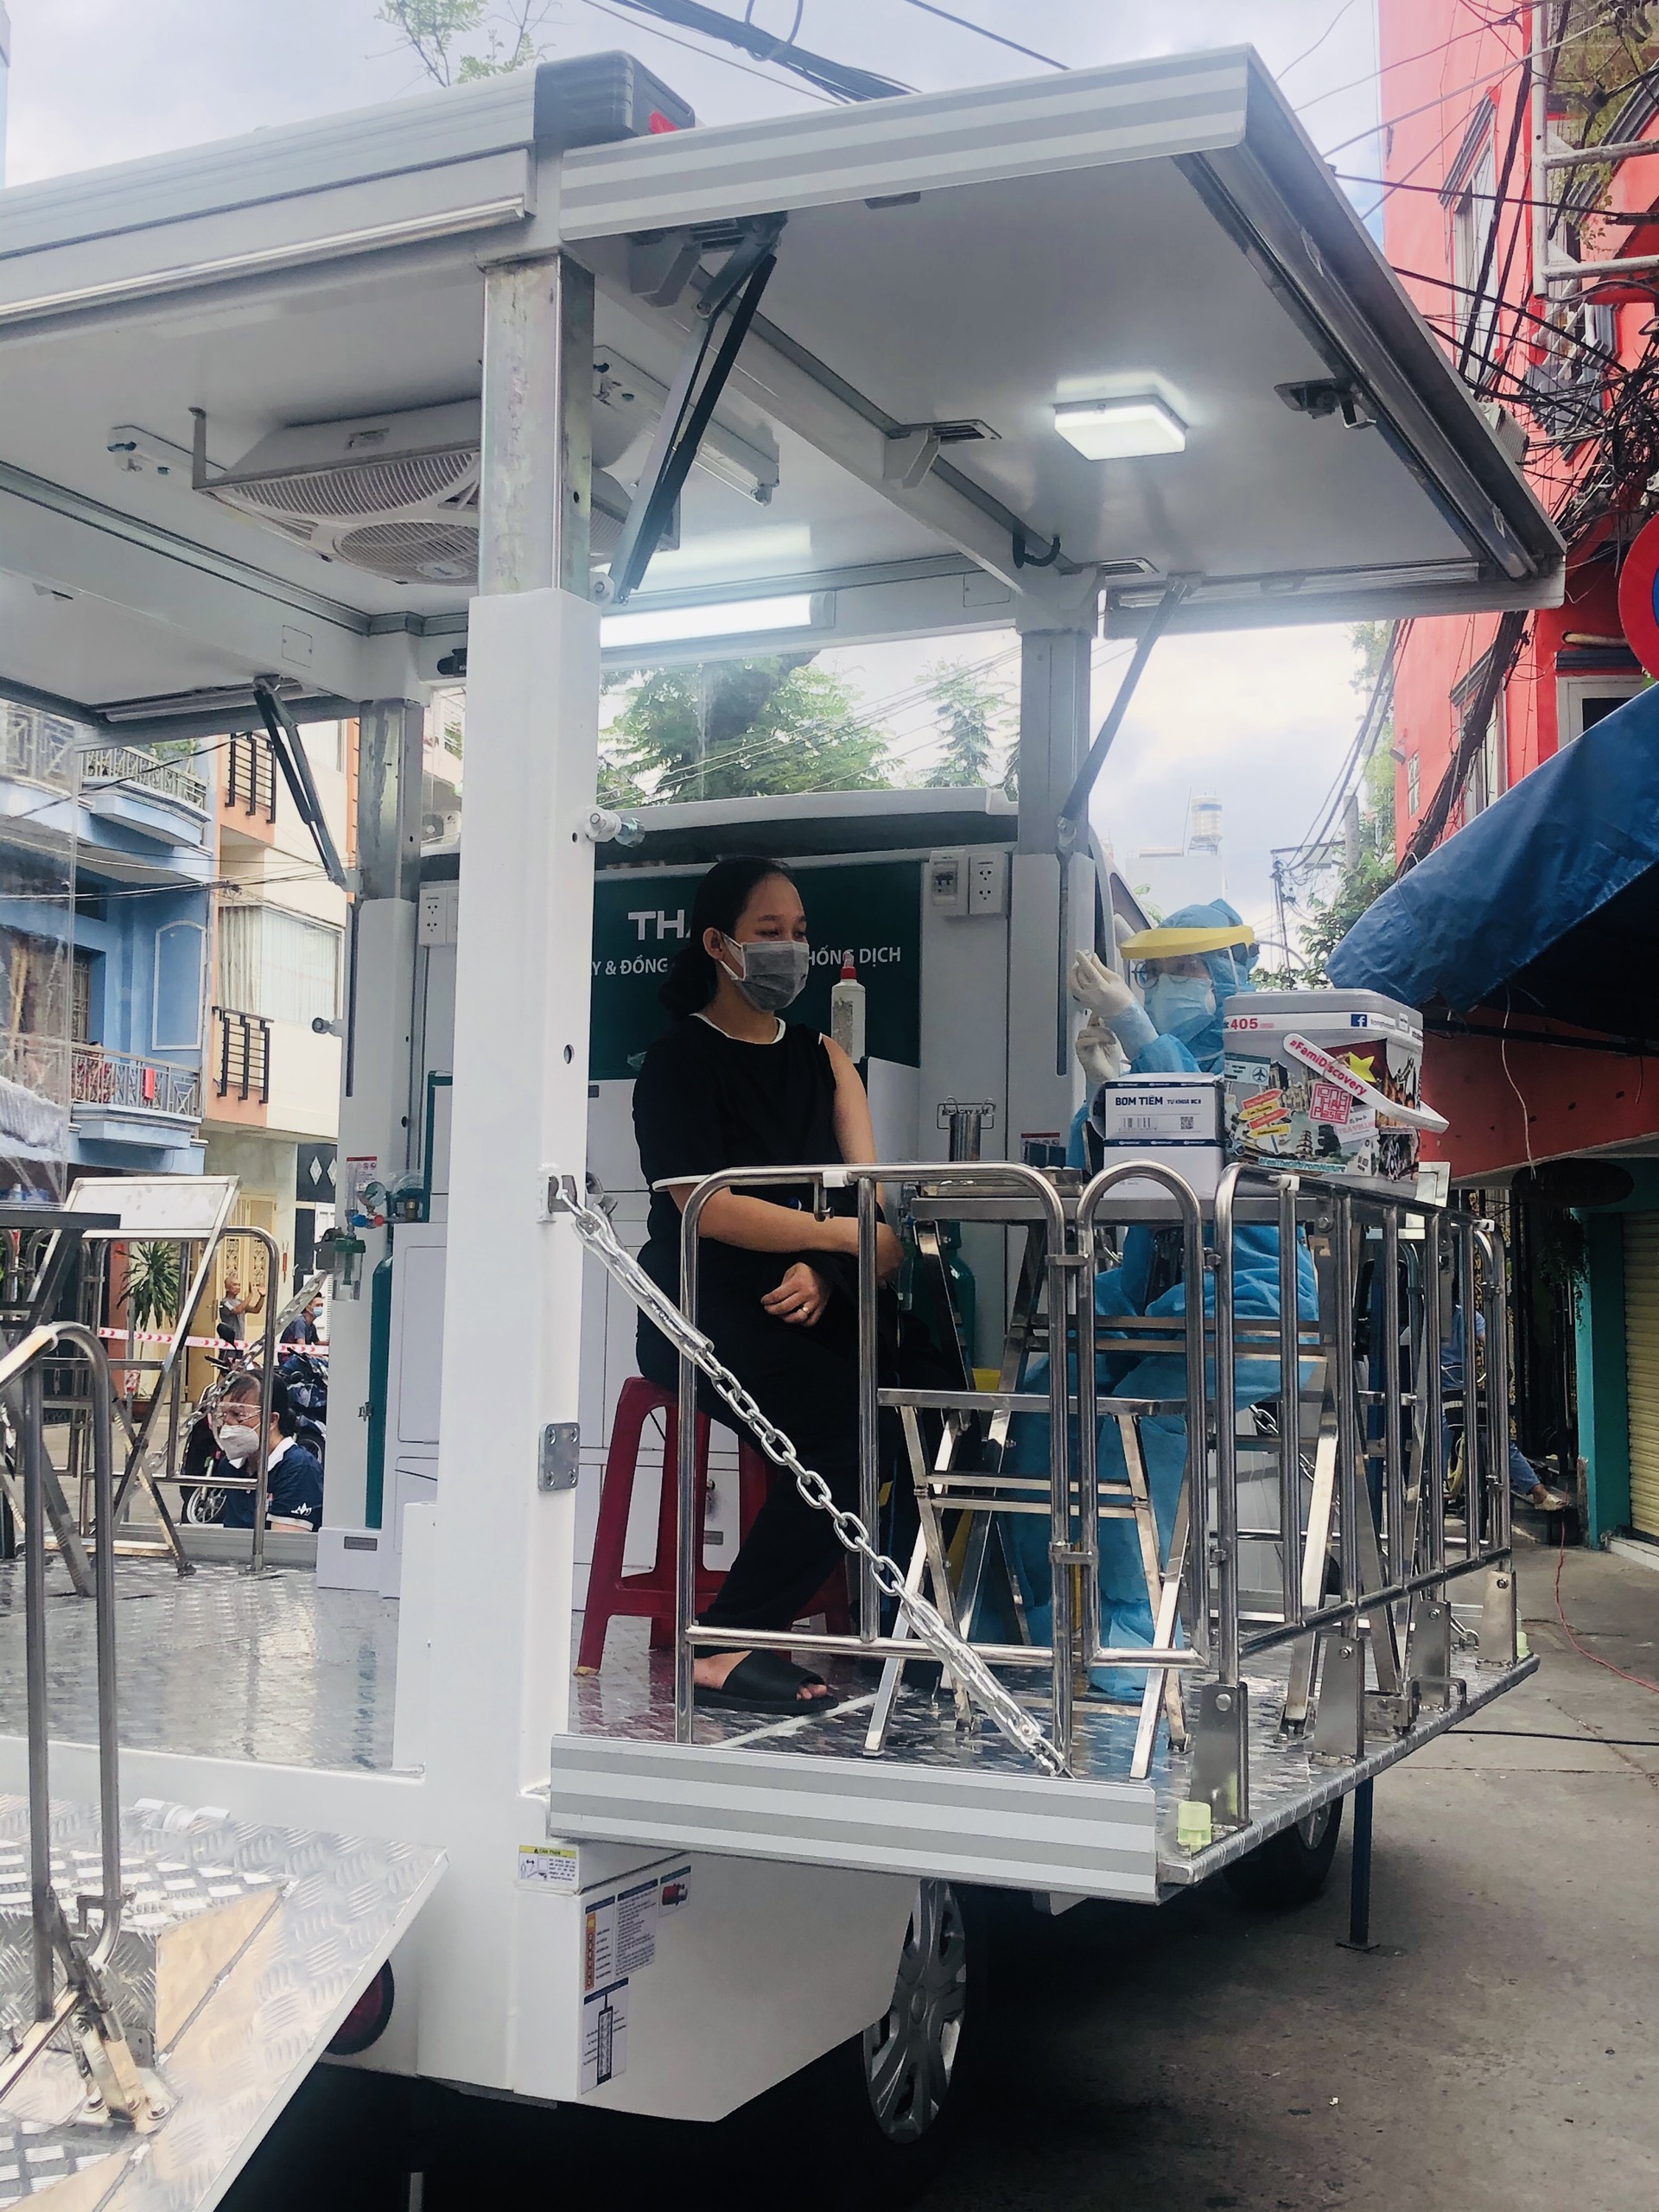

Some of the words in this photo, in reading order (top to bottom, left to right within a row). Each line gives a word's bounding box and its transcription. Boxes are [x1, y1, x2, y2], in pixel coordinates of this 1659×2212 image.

[627, 909, 690, 940] TH
[605, 960, 616, 975] &
[859, 946, 900, 967] DỊCH
[1230, 1018, 1258, 1030] 405
[1290, 1039, 1367, 1096] #FamiDiscovery
[1138, 1094, 1163, 1106] TIÊM
